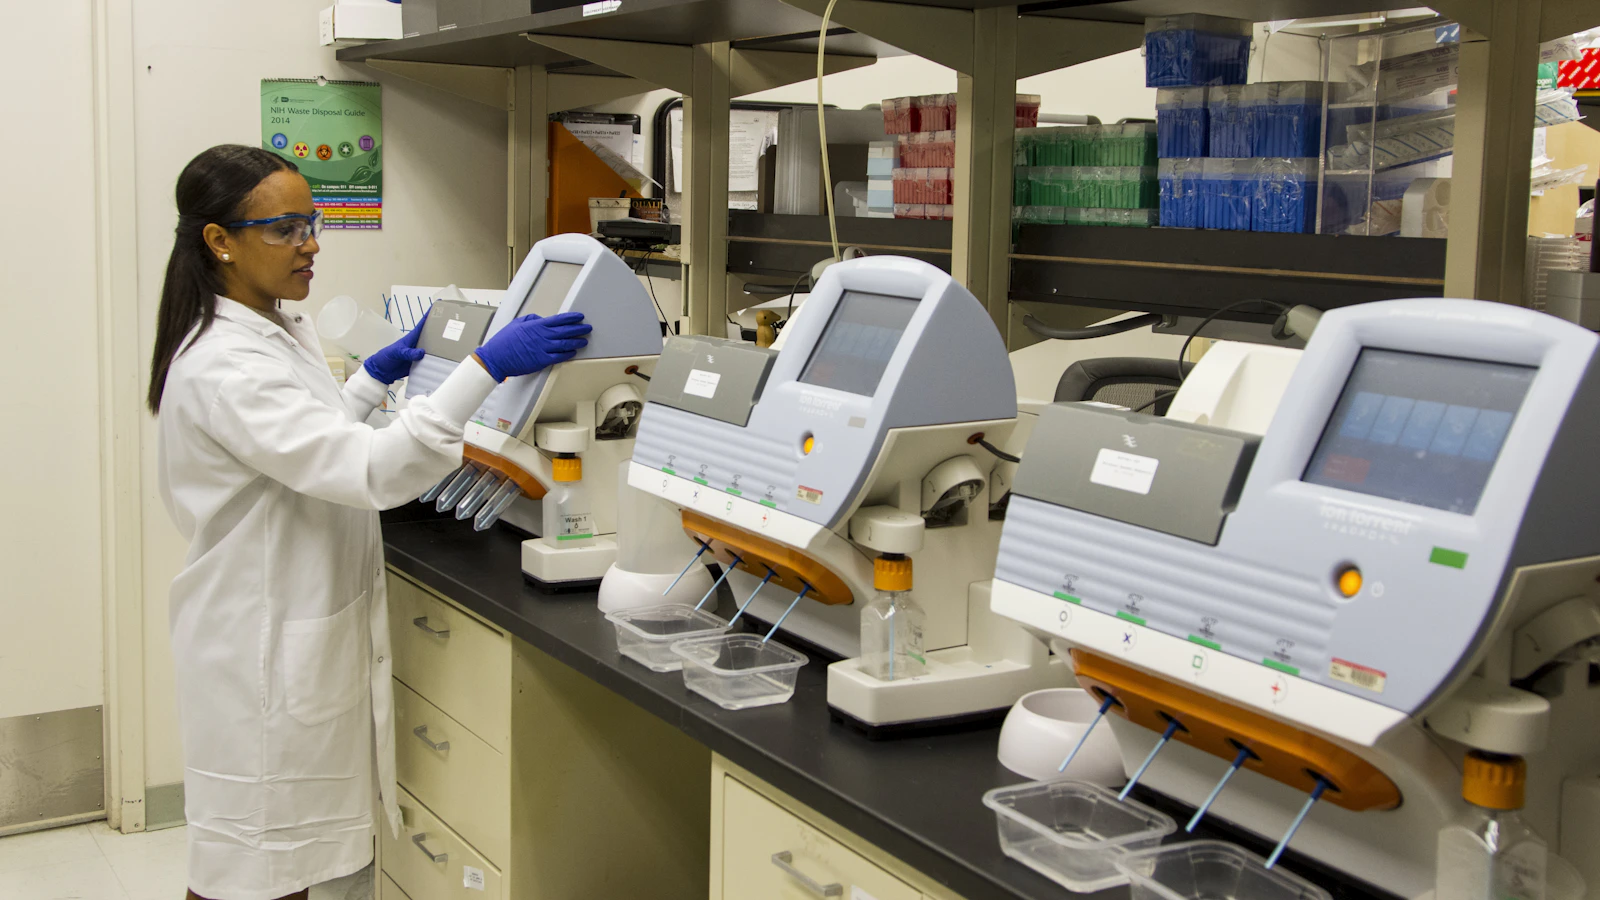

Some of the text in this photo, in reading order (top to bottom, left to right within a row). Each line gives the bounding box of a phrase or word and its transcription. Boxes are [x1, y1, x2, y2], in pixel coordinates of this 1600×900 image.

[288, 107, 310, 115] Waste
[312, 108, 342, 117] Disposal
[344, 109, 366, 117] Guide
